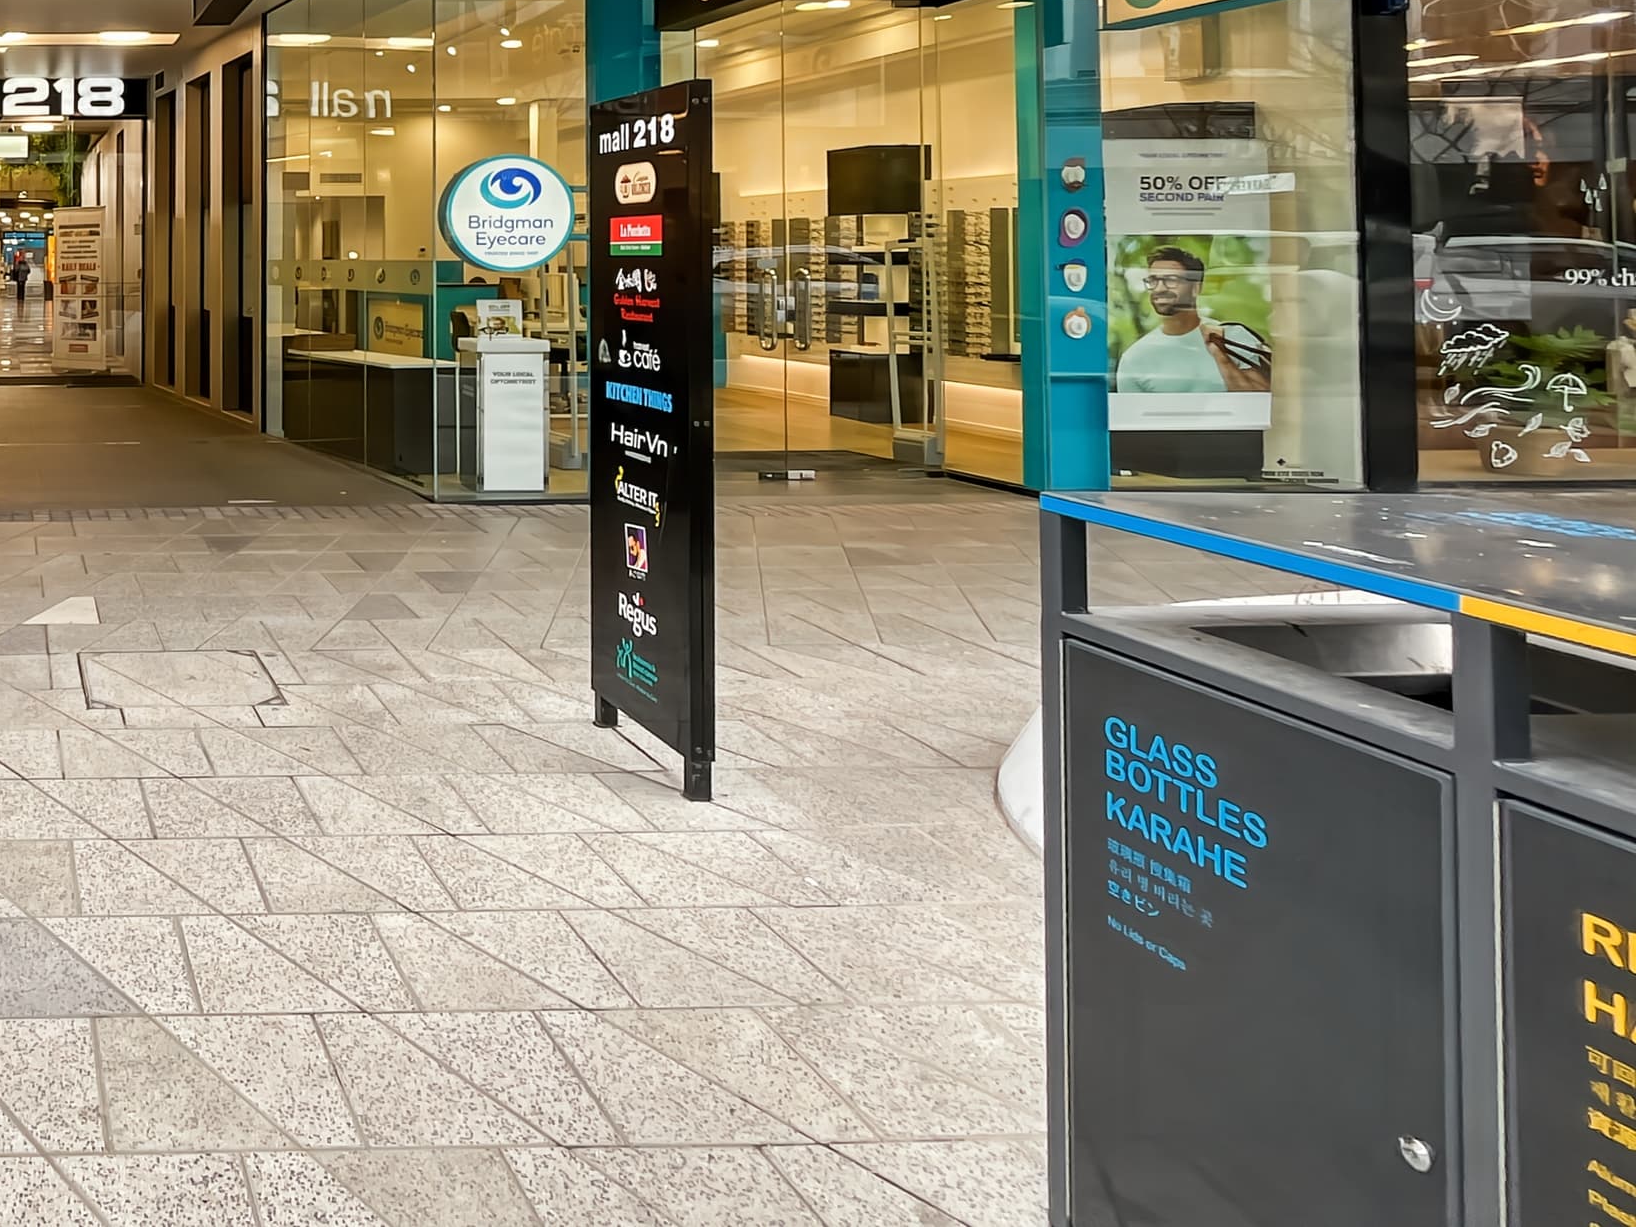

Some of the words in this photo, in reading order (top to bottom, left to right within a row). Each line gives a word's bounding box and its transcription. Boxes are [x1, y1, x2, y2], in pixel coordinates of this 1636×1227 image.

[2, 77, 125, 117] 218
[599, 122, 630, 154] mall
[633, 113, 675, 148] 218
[1139, 175, 1183, 191] 50%
[1188, 176, 1227, 191] OFF
[1139, 192, 1195, 202] SECOND
[468, 215, 554, 233] Bridgman
[476, 232, 546, 250] Eyecare
[1564, 268, 1607, 286] 99%
[633, 349, 661, 371] café
[606, 381, 643, 405] KITCHEN
[643, 387, 673, 413] THINGS
[616, 481, 647, 505] ALTER
[648, 491, 659, 508] IT
[618, 592, 657, 637] Regus
[1104, 716, 1218, 789] GLASS
[1105, 748, 1268, 848] BOTTLES
[1106, 790, 1247, 888] KARAHE
